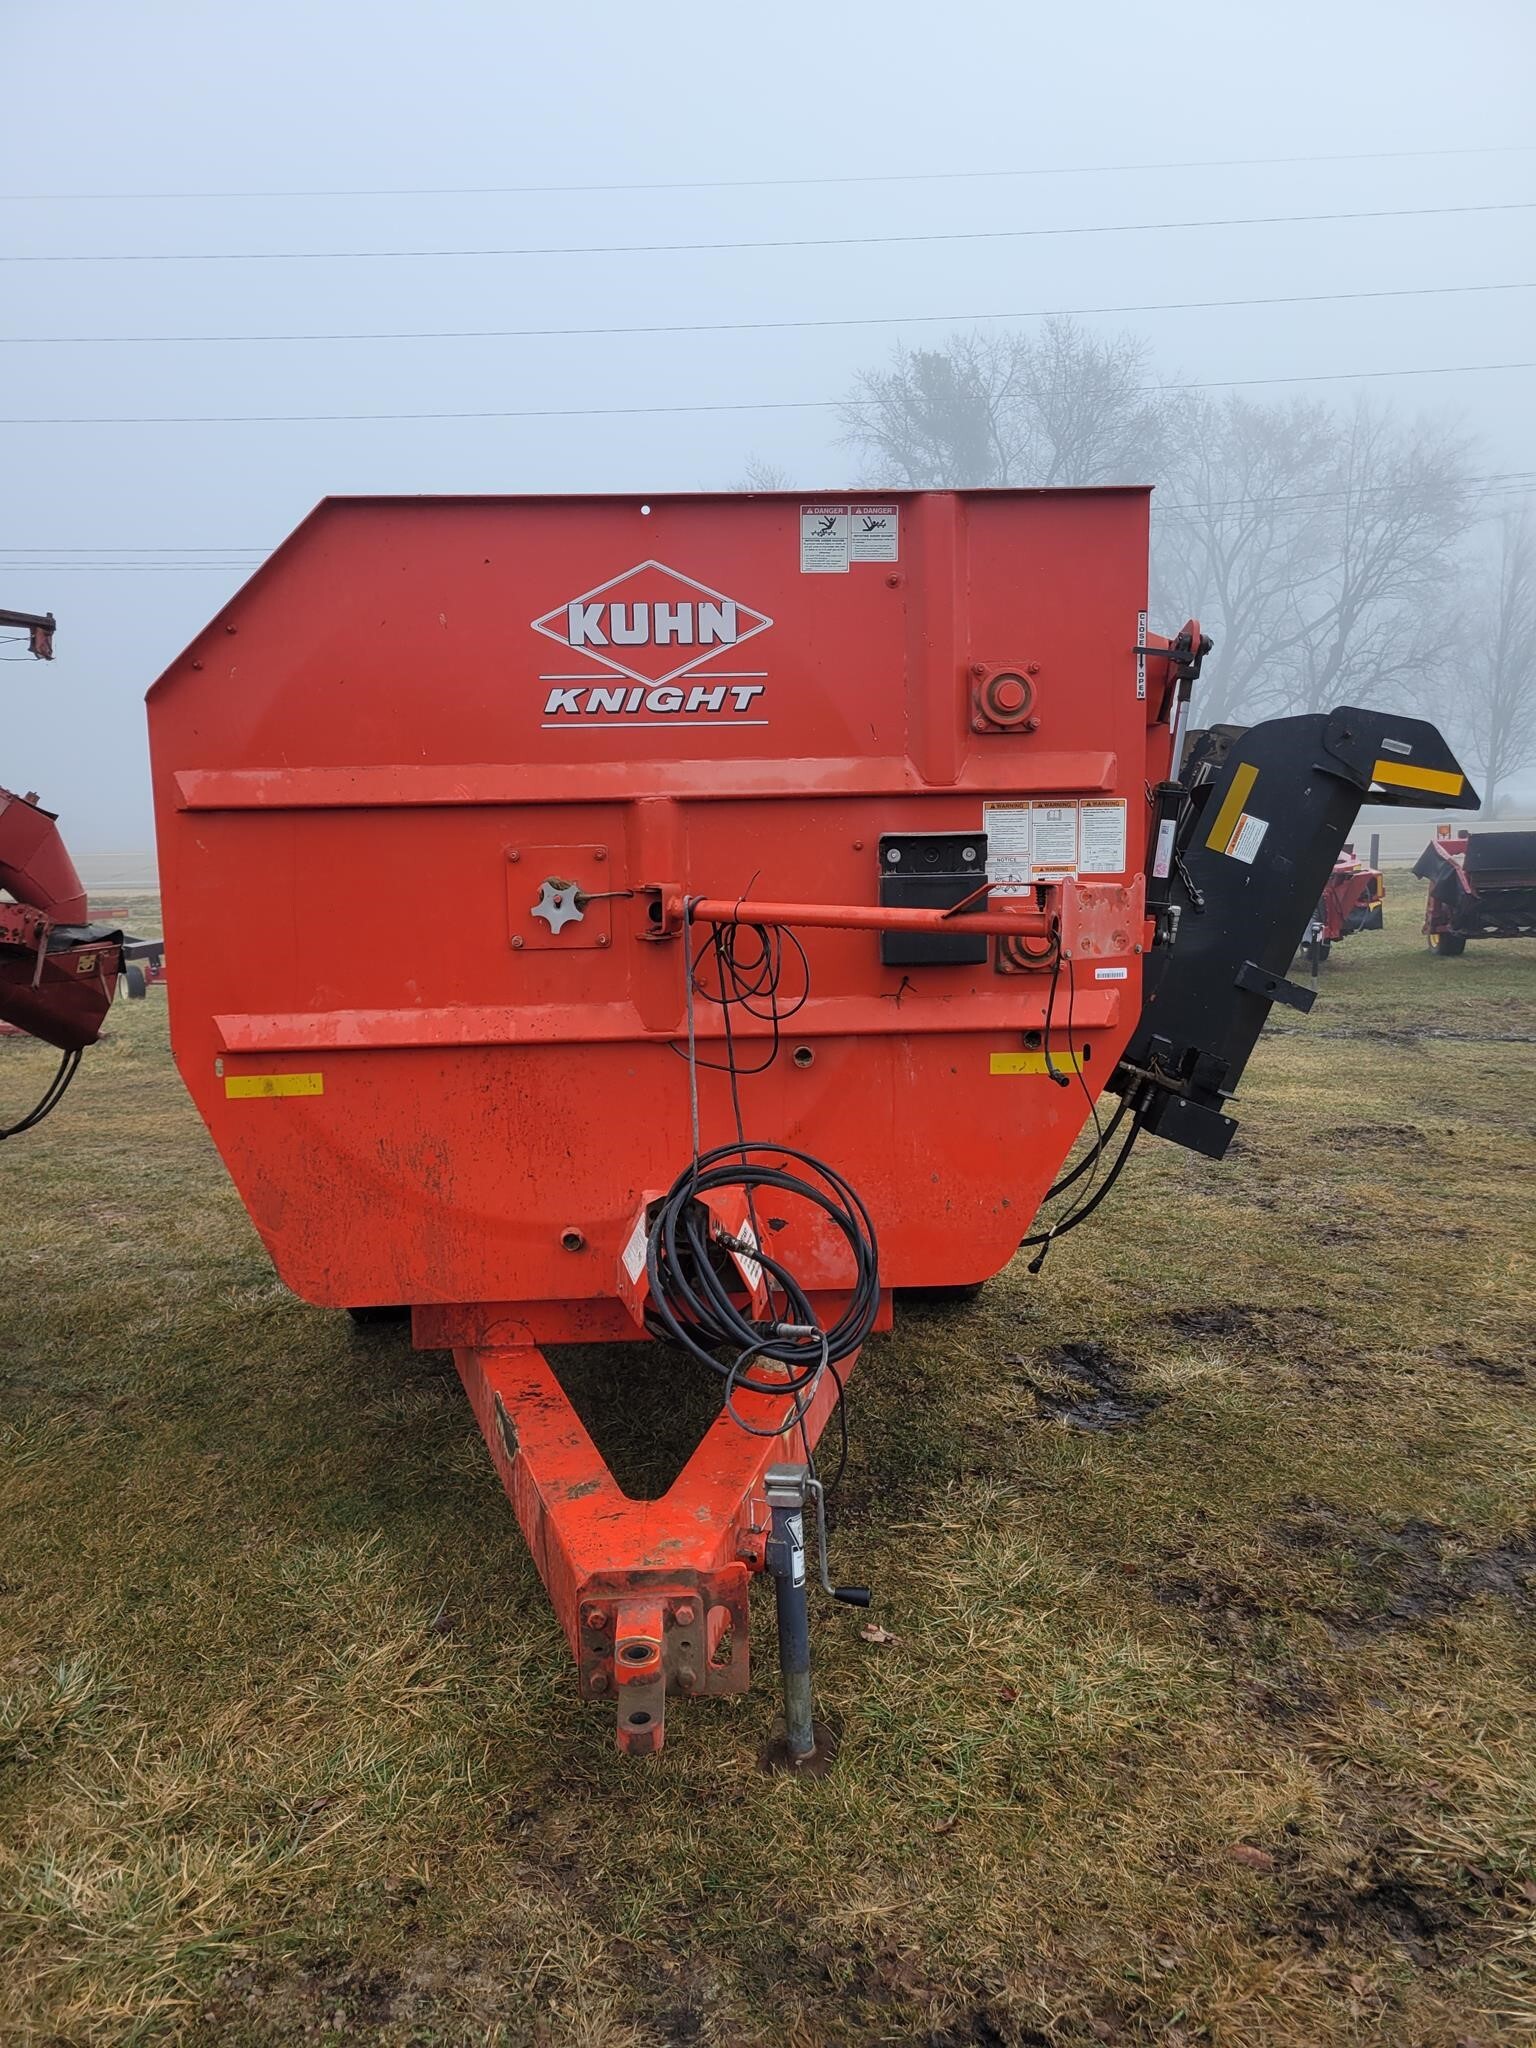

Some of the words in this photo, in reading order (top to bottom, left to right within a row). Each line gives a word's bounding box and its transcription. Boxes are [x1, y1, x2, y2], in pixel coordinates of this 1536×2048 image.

[567, 602, 738, 646] KUHN
[1138, 613, 1146, 646] CLOSE
[1137, 671, 1145, 697] OPEN
[543, 685, 765, 715] KNIGHT
